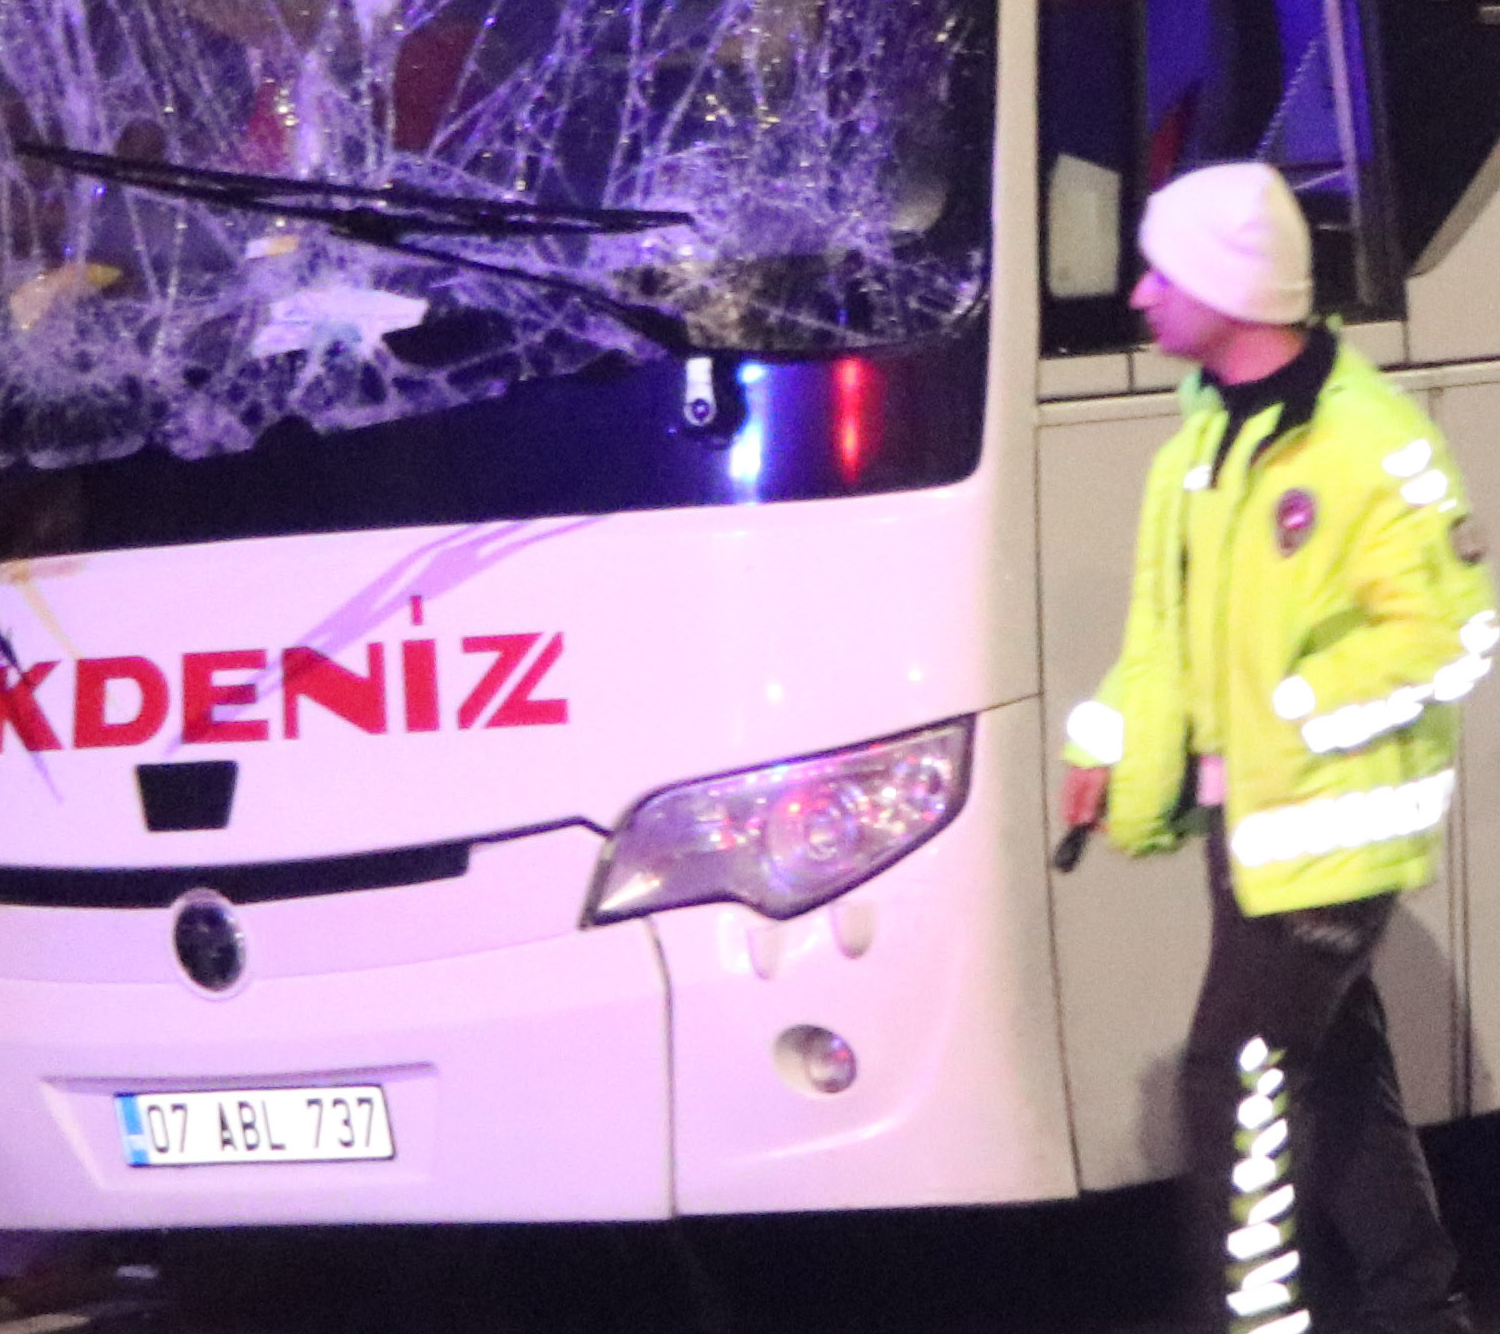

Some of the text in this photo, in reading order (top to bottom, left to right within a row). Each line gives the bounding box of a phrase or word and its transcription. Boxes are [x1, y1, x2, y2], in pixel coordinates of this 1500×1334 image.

[147, 1097, 375, 1154] 07 ABL 737
